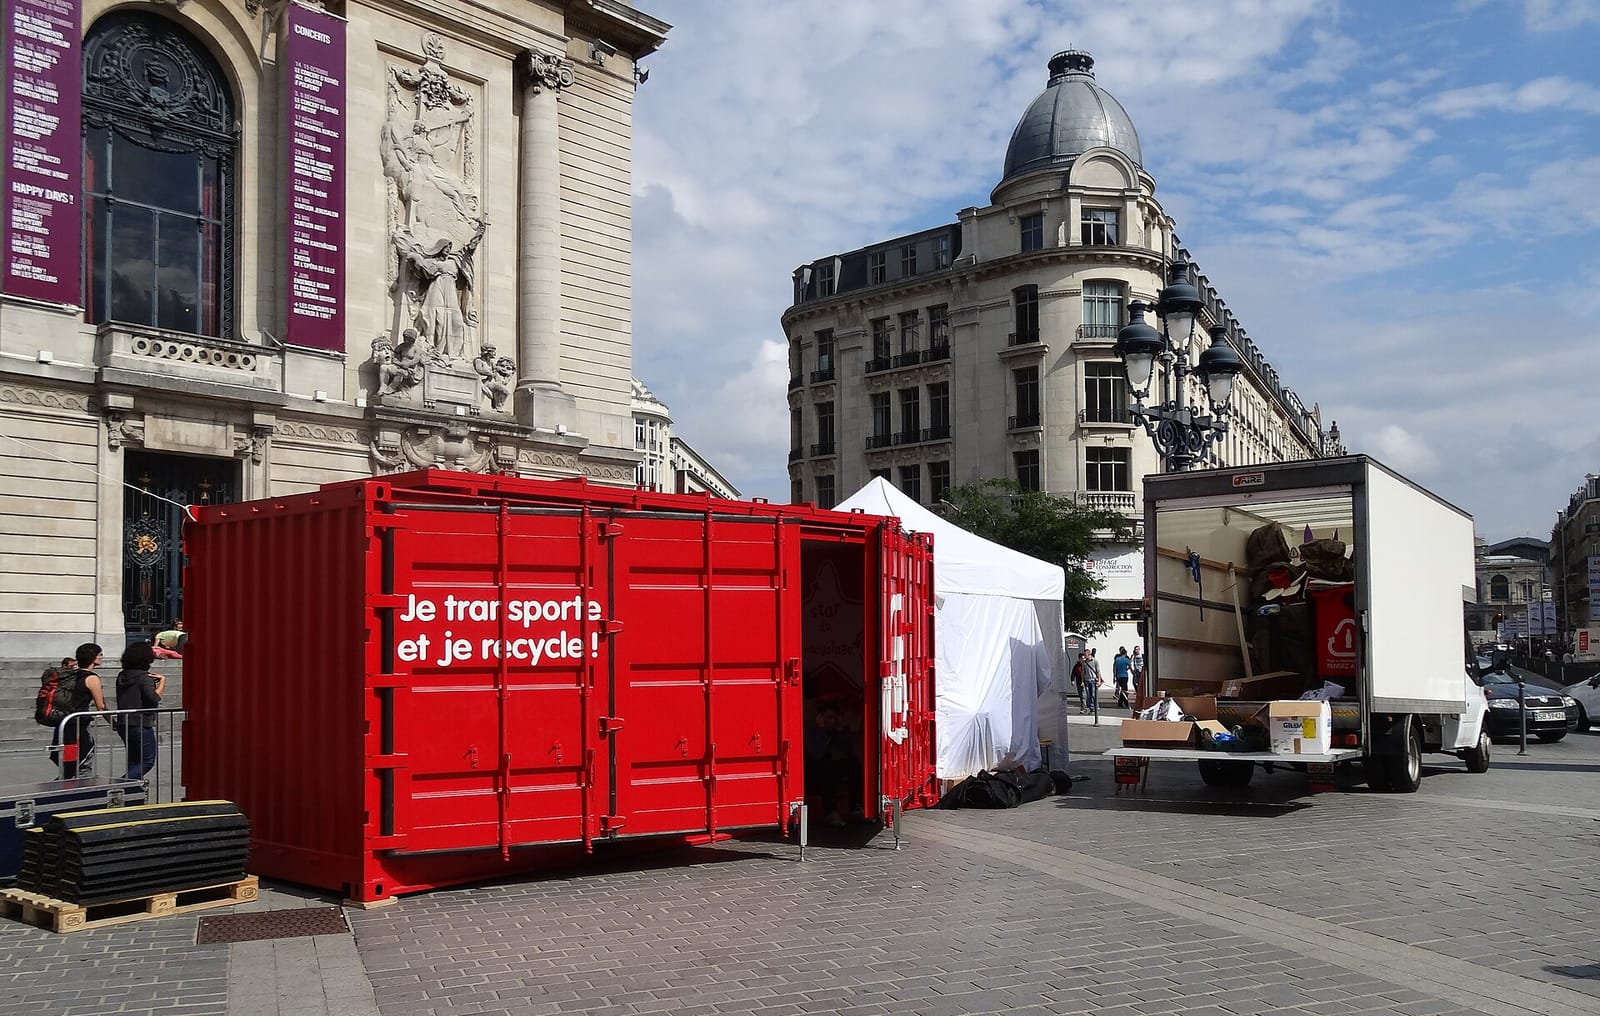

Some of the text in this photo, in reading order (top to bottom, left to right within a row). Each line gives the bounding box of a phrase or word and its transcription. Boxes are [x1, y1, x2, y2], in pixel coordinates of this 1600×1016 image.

[294, 24, 331, 45] CONCERTS
[12, 181, 44, 198] HAPPY
[400, 594, 602, 629] Je transporte
[397, 633, 430, 661] et
[436, 630, 473, 667] je
